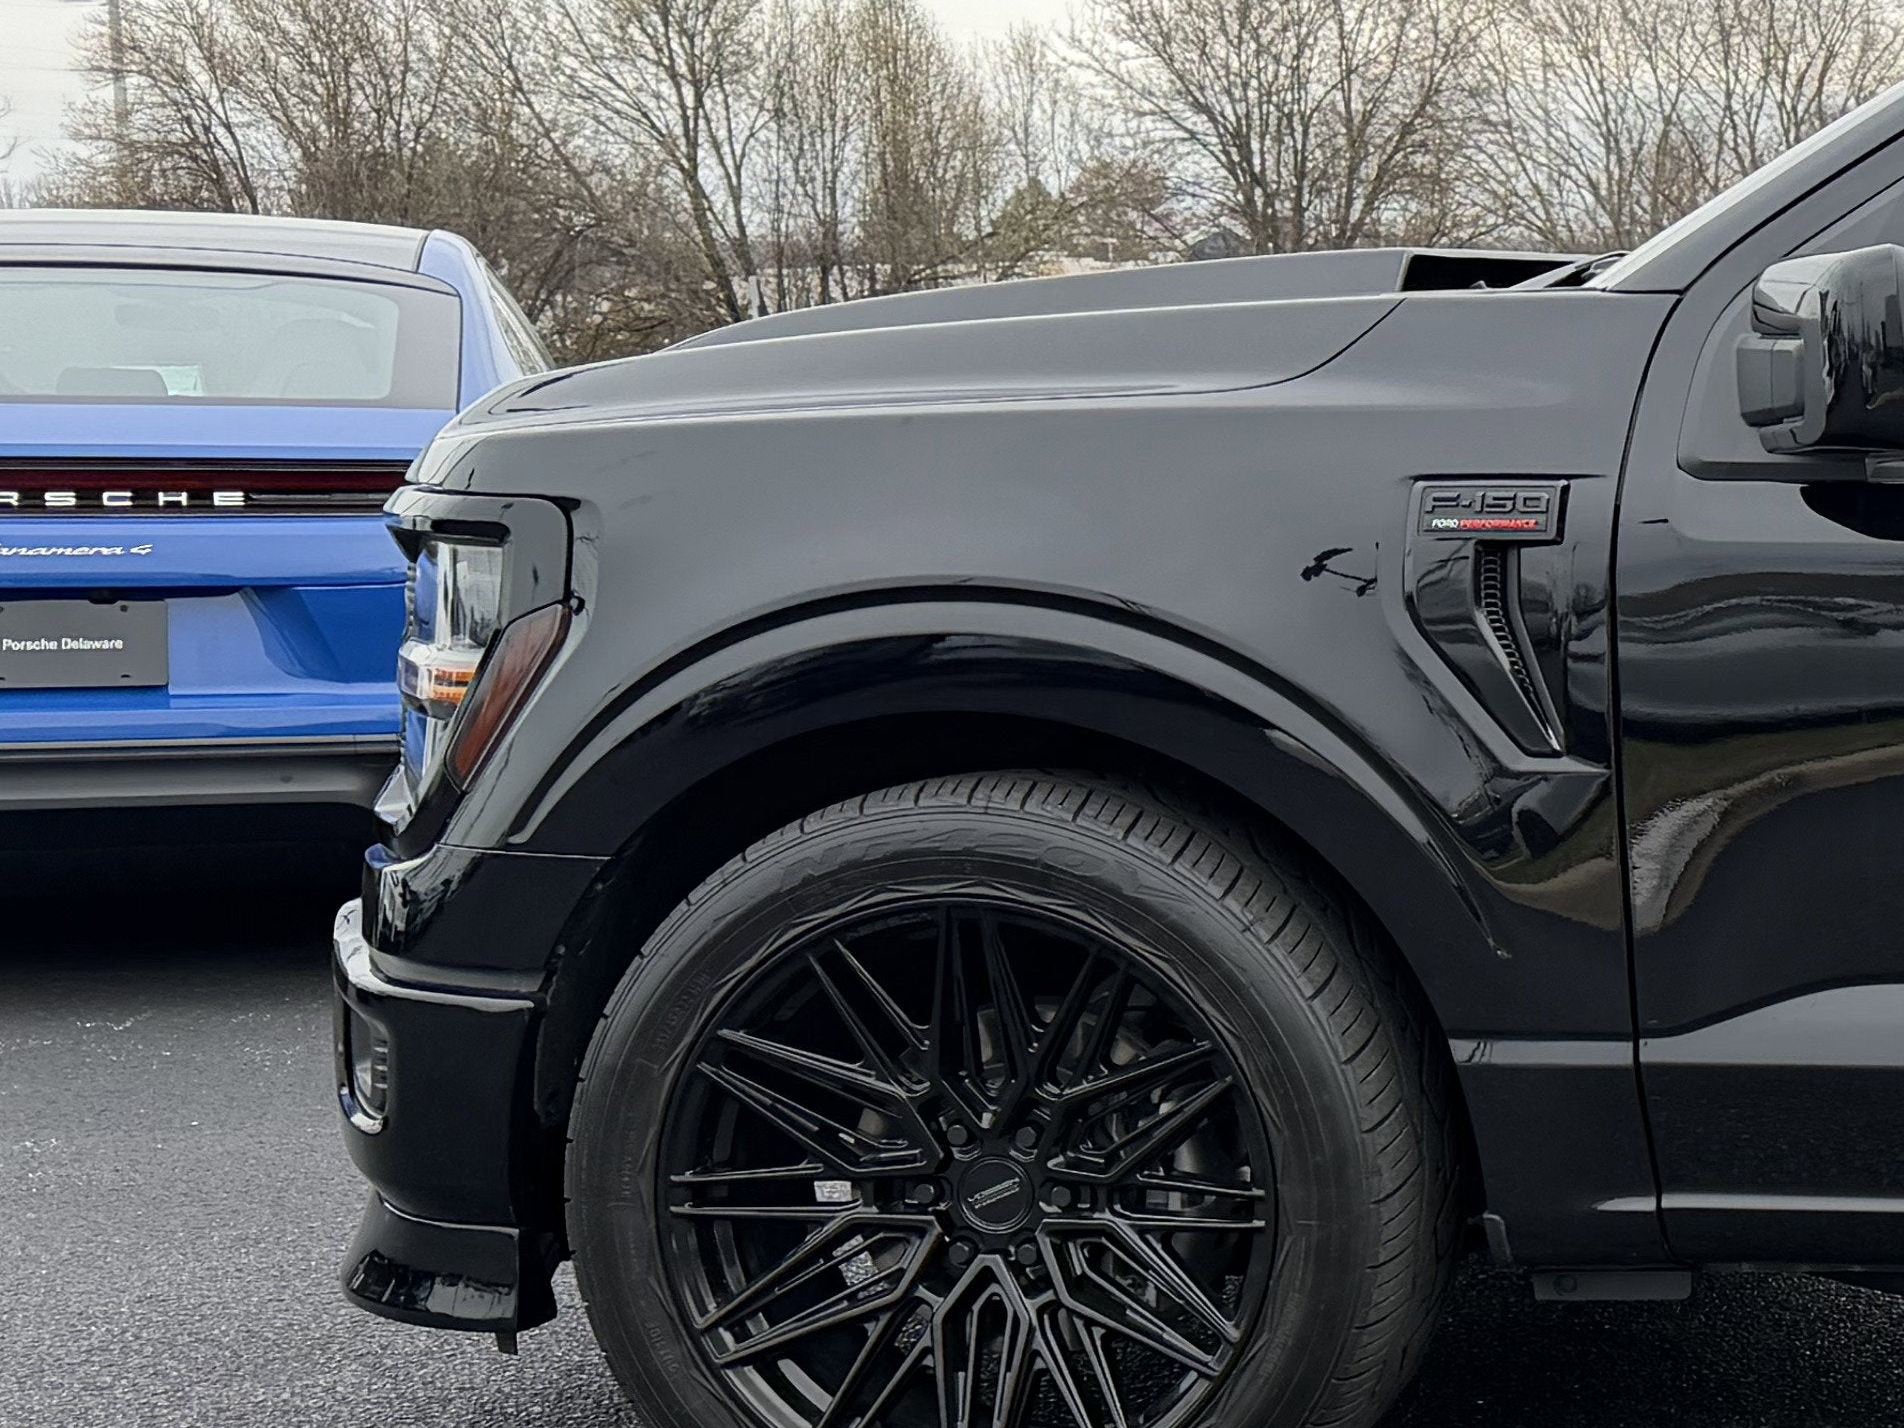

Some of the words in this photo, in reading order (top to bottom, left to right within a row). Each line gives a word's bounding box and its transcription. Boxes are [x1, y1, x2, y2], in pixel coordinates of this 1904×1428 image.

[1424, 492, 1550, 514] F-150
[130, 544, 153, 556] 4
[2, 638, 58, 651] Porsche
[61, 637, 124, 650] Delaware
